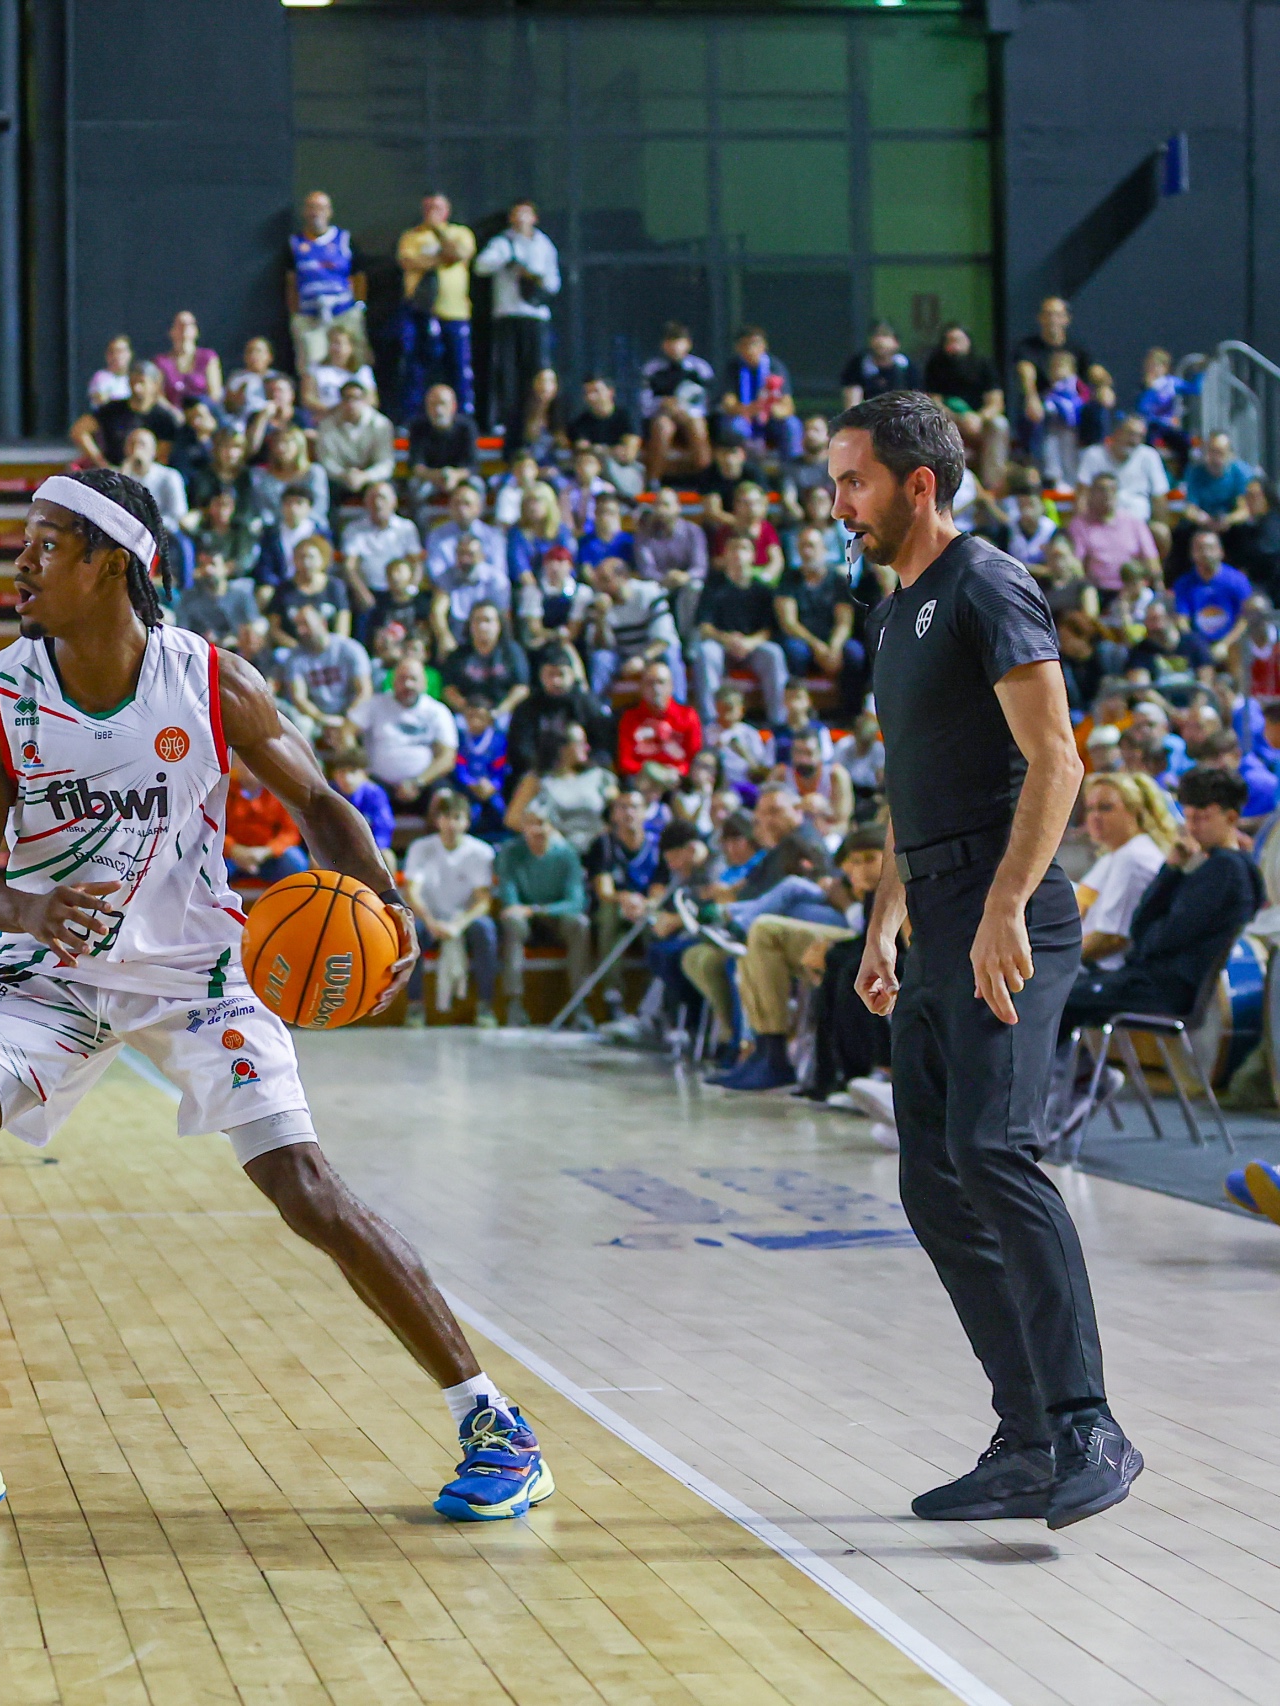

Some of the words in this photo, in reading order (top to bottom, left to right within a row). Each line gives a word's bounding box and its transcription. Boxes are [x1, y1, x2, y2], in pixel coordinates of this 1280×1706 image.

[94, 730, 113, 740] 1982
[45, 772, 168, 820] fibwi
[223, 1005, 255, 1019] Palma
